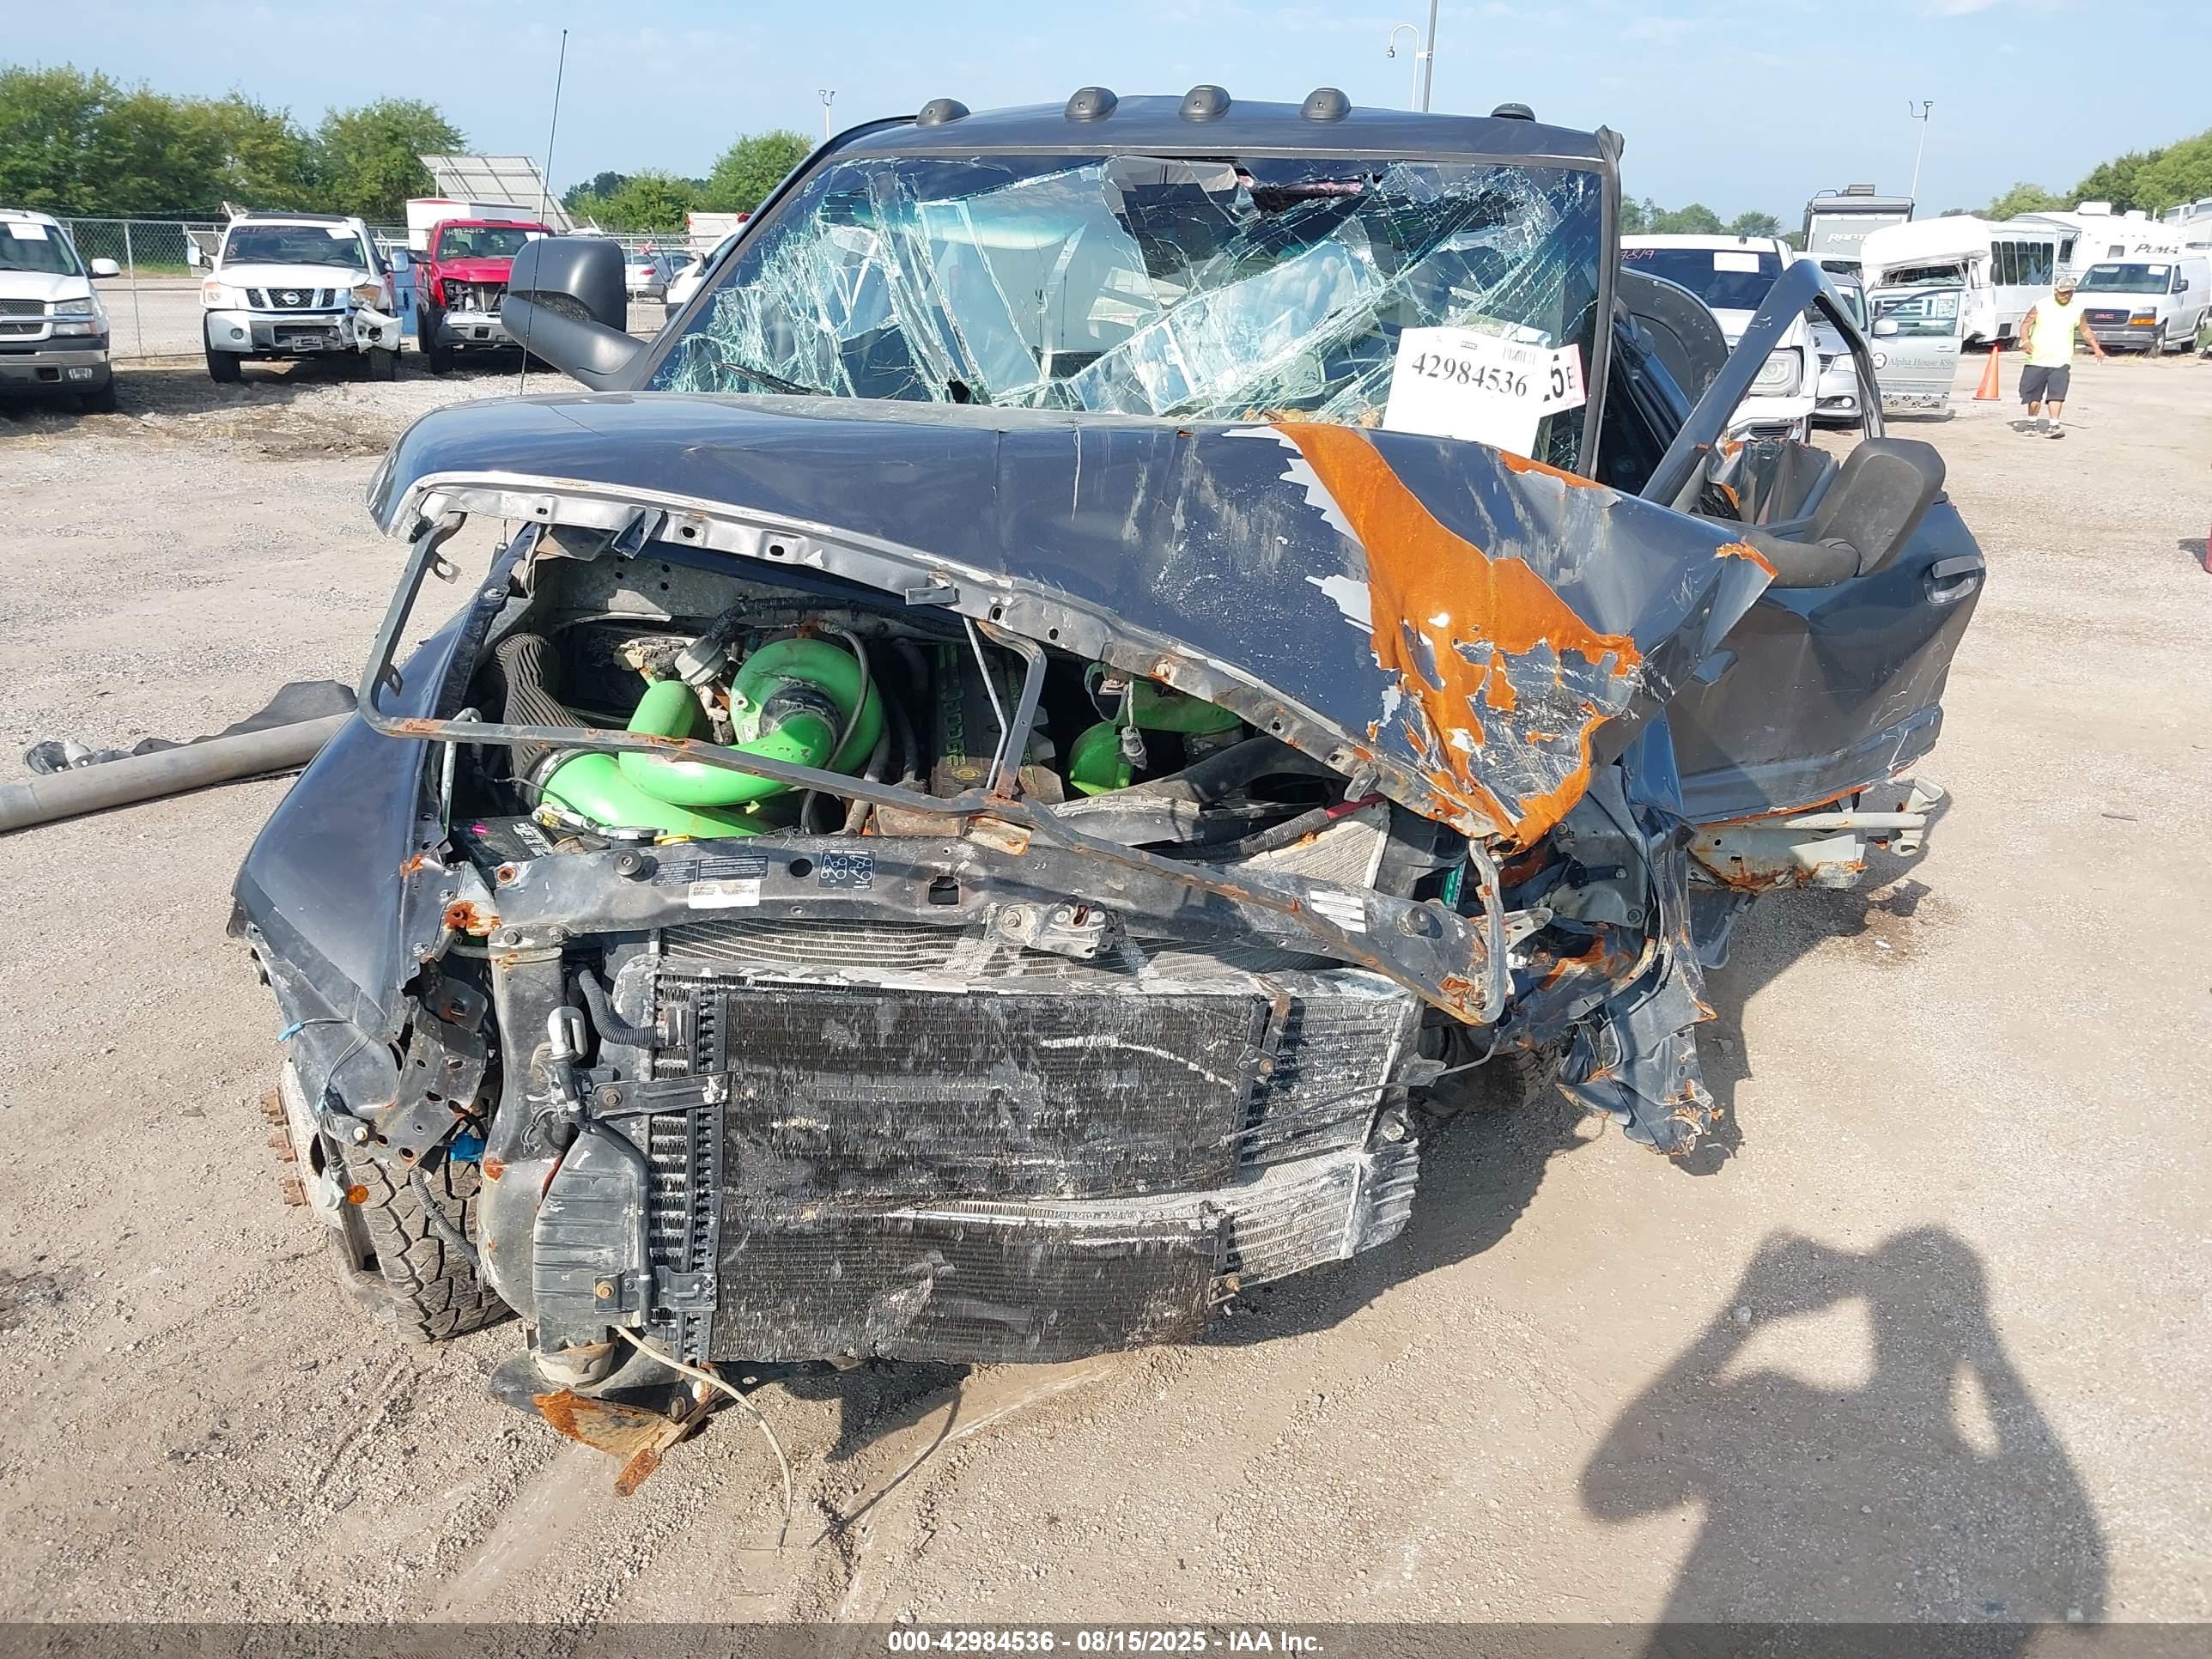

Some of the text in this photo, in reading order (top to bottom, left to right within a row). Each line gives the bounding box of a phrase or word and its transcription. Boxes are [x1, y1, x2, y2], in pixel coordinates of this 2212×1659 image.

[1826, 233, 1867, 244] RAPT
[1887, 357, 1911, 368] Alpha
[1913, 358, 1938, 367] House
[1411, 351, 1531, 398] 42984536
